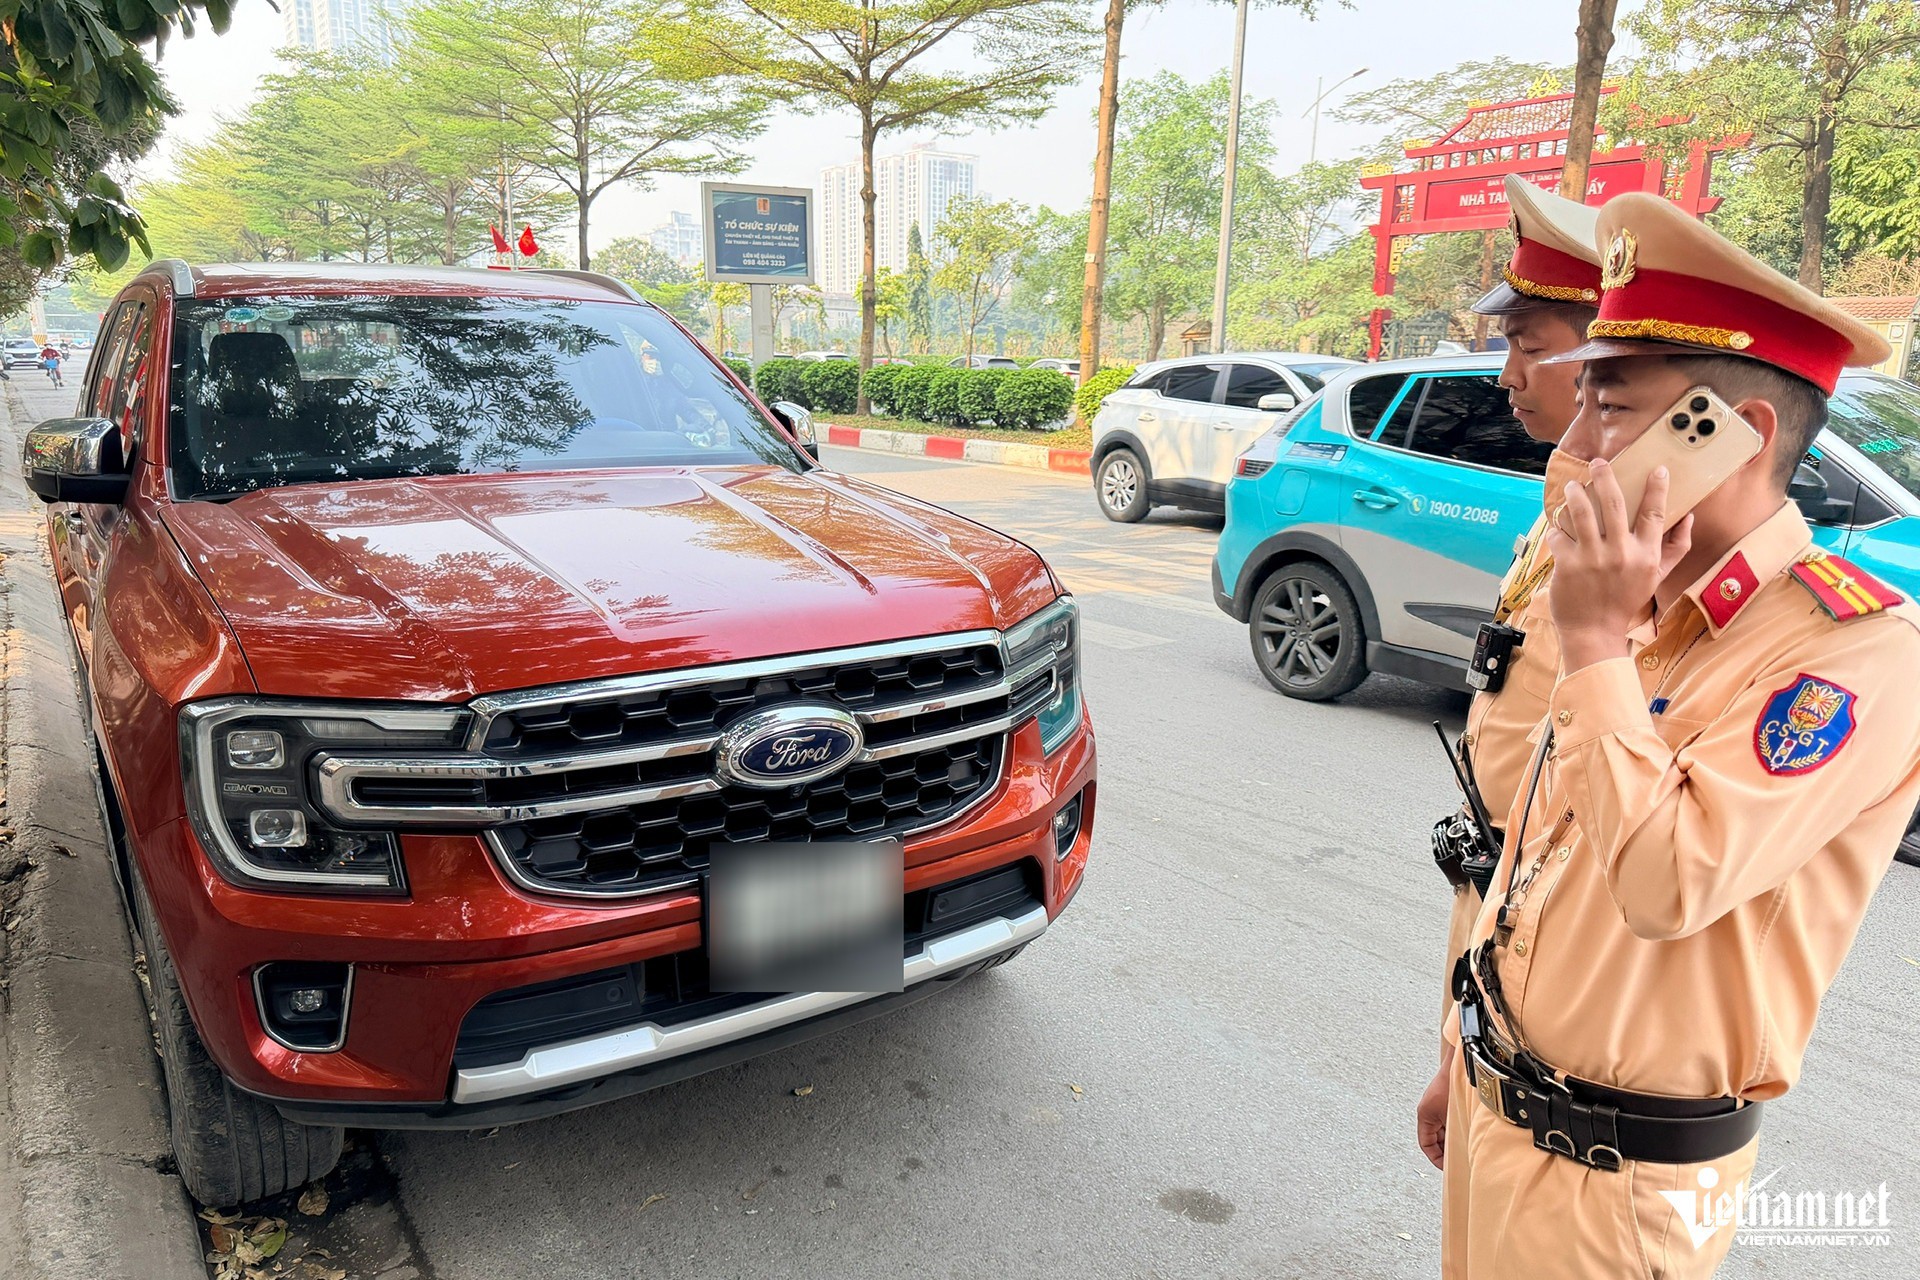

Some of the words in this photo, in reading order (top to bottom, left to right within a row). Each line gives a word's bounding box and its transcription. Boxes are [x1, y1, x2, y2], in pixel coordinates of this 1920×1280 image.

[1460, 190, 1485, 207] NHÀ
[1488, 191, 1510, 205] TAN
[739, 220, 763, 231] CHỨC
[765, 222, 778, 233] SỰ
[779, 222, 799, 233] KIỆN
[1429, 500, 1461, 518] 1900
[1462, 506, 1499, 525] 2088
[1764, 720, 1830, 754] CSGT
[766, 734, 833, 770] Ford
